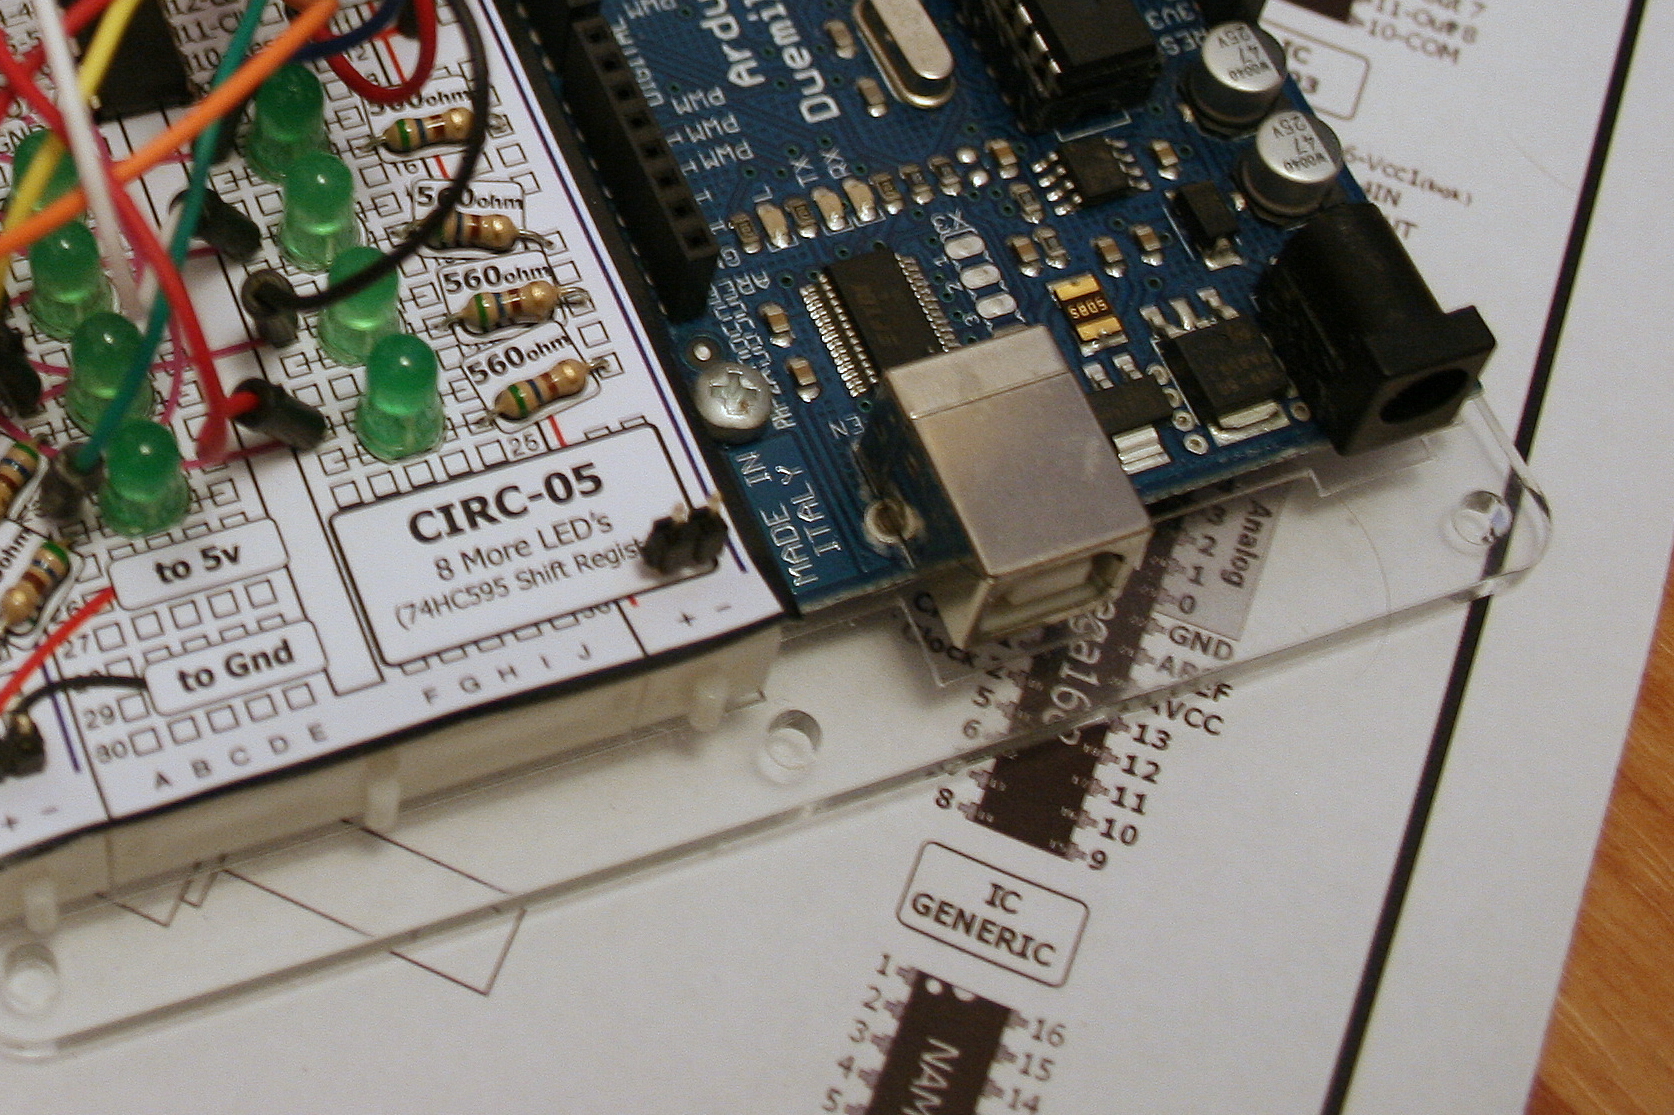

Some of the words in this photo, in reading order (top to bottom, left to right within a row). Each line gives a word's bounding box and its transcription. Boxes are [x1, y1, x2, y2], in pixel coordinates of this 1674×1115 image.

[1144, 2, 1197, 31] 3V3
[1238, 45, 1261, 65] 47
[671, 85, 726, 116] PWM
[685, 113, 741, 143] PWM
[701, 139, 755, 172] PWM
[1292, 132, 1317, 155] 47
[790, 155, 820, 187] TX
[416, 186, 524, 211] 50ohm
[443, 265, 553, 295] 560ohm
[467, 333, 572, 384] 560ohm
[736, 451, 773, 488] IN
[408, 461, 606, 545] CIRC-05
[775, 464, 842, 559] ITALY
[434, 556, 454, 582] 8
[461, 537, 532, 576] More
[535, 511, 615, 552] LED's
[761, 502, 819, 588] MADE
[1193, 534, 1217, 557] 2
[1220, 499, 1273, 590] Analog
[154, 559, 192, 585] to
[200, 544, 242, 572] 5v
[1189, 565, 1205, 585] 1
[394, 577, 509, 632] (74HC595
[516, 559, 570, 593] Shift
[576, 537, 645, 573] Regist
[1169, 626, 1234, 662] GND
[177, 667, 216, 693] to
[224, 638, 296, 679] Gnd
[972, 687, 993, 709] 5
[83, 704, 116, 730] 29
[962, 719, 981, 740] 6
[1131, 721, 1172, 752] 13
[155, 772, 172, 789] A
[191, 758, 212, 779] B
[230, 745, 250, 767] C
[269, 736, 289, 755] D
[1123, 754, 1163, 784] 12
[934, 787, 955, 810] 8
[1111, 784, 1148, 815] 11
[1099, 816, 1139, 846] 10
[1088, 850, 1108, 870] 9
[984, 882, 1023, 914] IC
[912, 892, 1057, 969] GENERIC
[876, 953, 893, 976] 1
[862, 985, 882, 1012] 2
[850, 1019, 870, 1045] 3
[1030, 1017, 1067, 1048] 16
[836, 1055, 856, 1079] 4
[1018, 1052, 1055, 1083] 15
[823, 1088, 843, 1112] 5
[1007, 1087, 1041, 1114] 14
